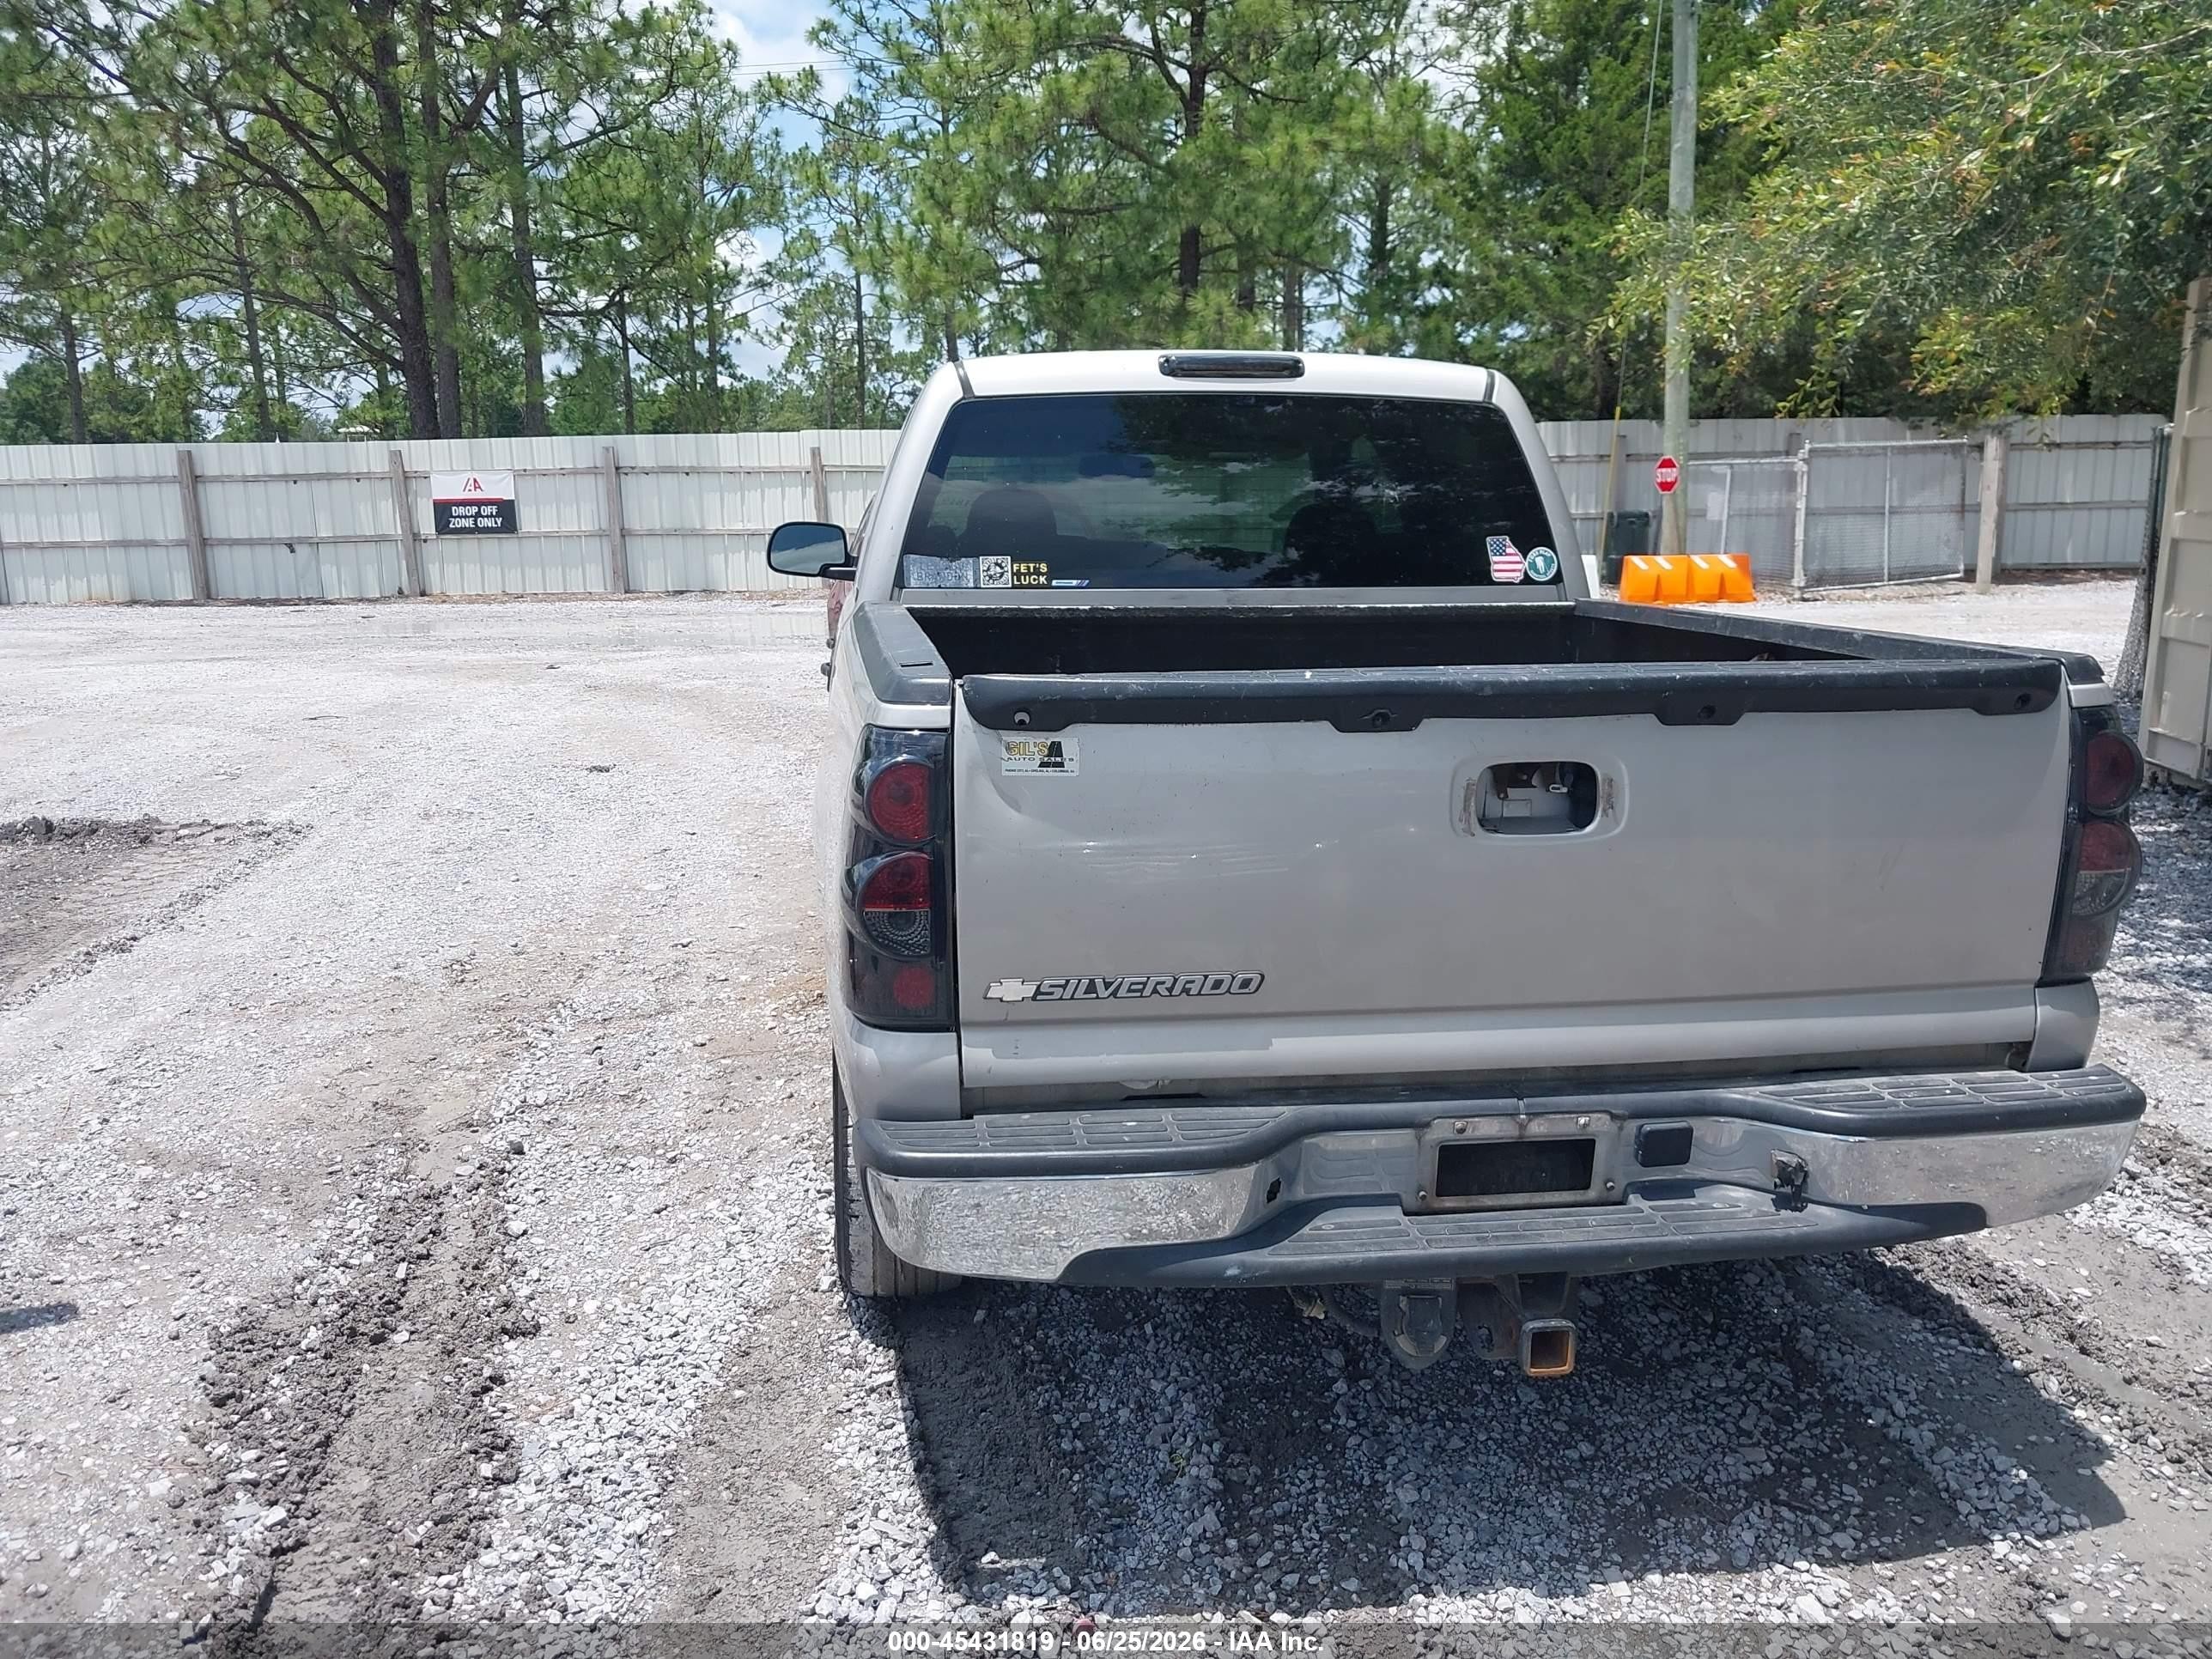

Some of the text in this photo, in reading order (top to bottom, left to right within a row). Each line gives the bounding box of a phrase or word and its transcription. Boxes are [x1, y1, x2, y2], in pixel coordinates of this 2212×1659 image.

[452, 505, 498, 516] DROP OFF
[448, 517, 502, 528] ZONE ONLY
[1013, 562, 1048, 573] FET'S
[1013, 574, 1048, 585] LUCK
[1006, 741, 1048, 757] GIL'S
[1034, 971, 1264, 1001] SILVERADO
